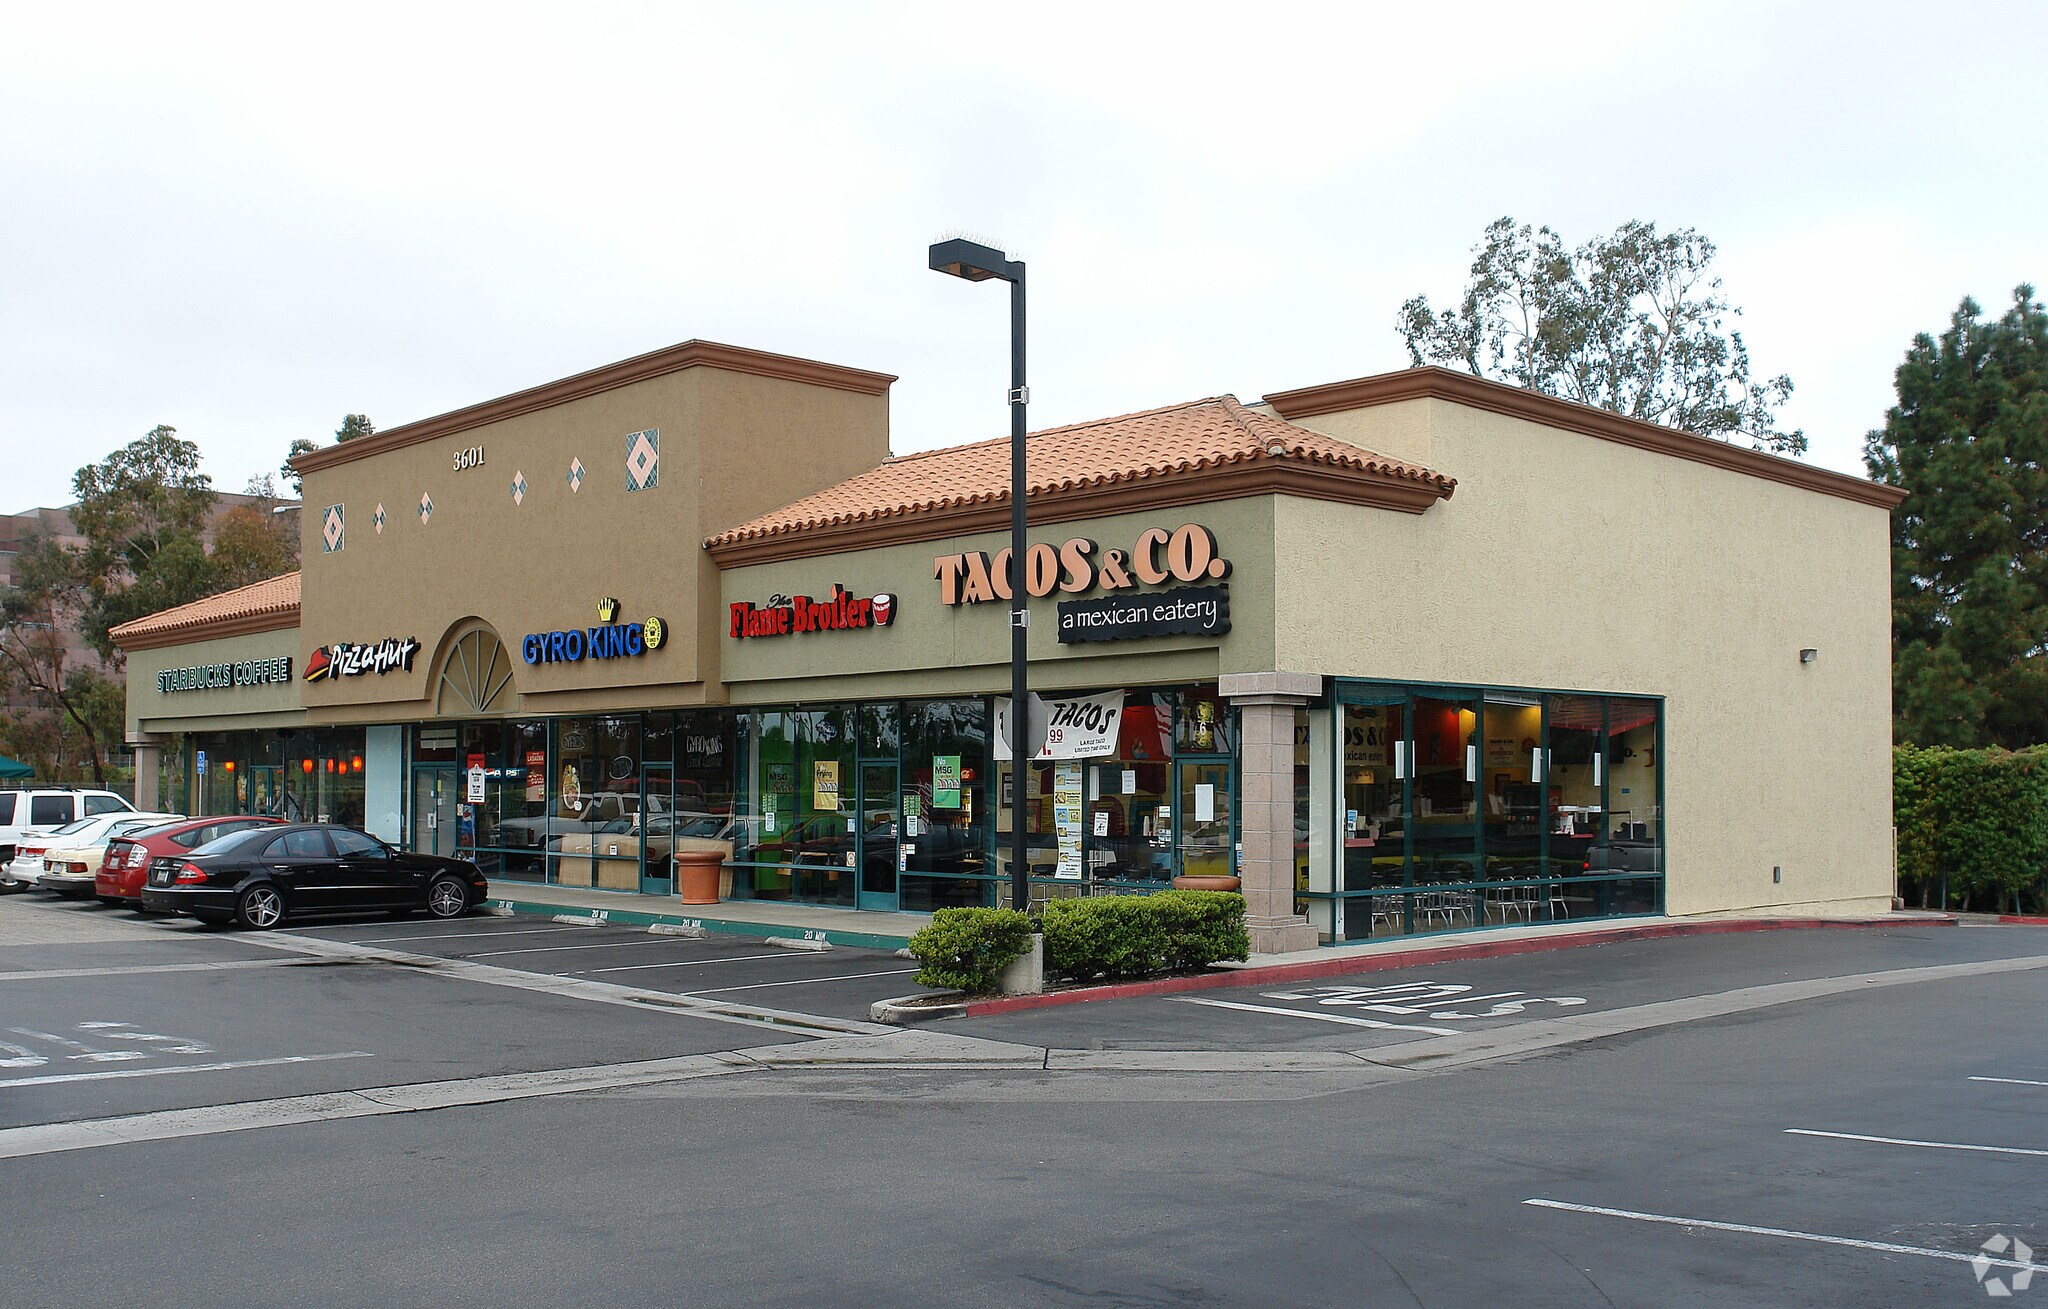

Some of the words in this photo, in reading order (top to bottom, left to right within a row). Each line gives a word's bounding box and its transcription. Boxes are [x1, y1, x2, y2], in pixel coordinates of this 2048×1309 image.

[453, 445, 484, 471] 3601
[933, 537, 1091, 606] TACOS
[1100, 548, 1132, 590] &
[1133, 523, 1226, 585] CO.
[766, 593, 793, 608] The
[730, 602, 789, 638] Flame
[792, 585, 870, 632] Broiler
[1062, 613, 1074, 629] a
[1077, 604, 1148, 627] mexican
[1152, 599, 1218, 629] eatery
[522, 629, 583, 665] GYRO
[588, 623, 643, 658] KING
[157, 663, 231, 692] STARBUCKS
[234, 656, 290, 686] COFFEE
[1050, 702, 1117, 735] TACOS
[1050, 729, 1063, 742] 99
[493, 769, 520, 777] PPSI
[769, 773, 788, 781] MSG
[934, 766, 952, 775] MSG
[591, 909, 598, 918] 20
[682, 918, 690, 927] 20
[804, 930, 813, 940] 20
